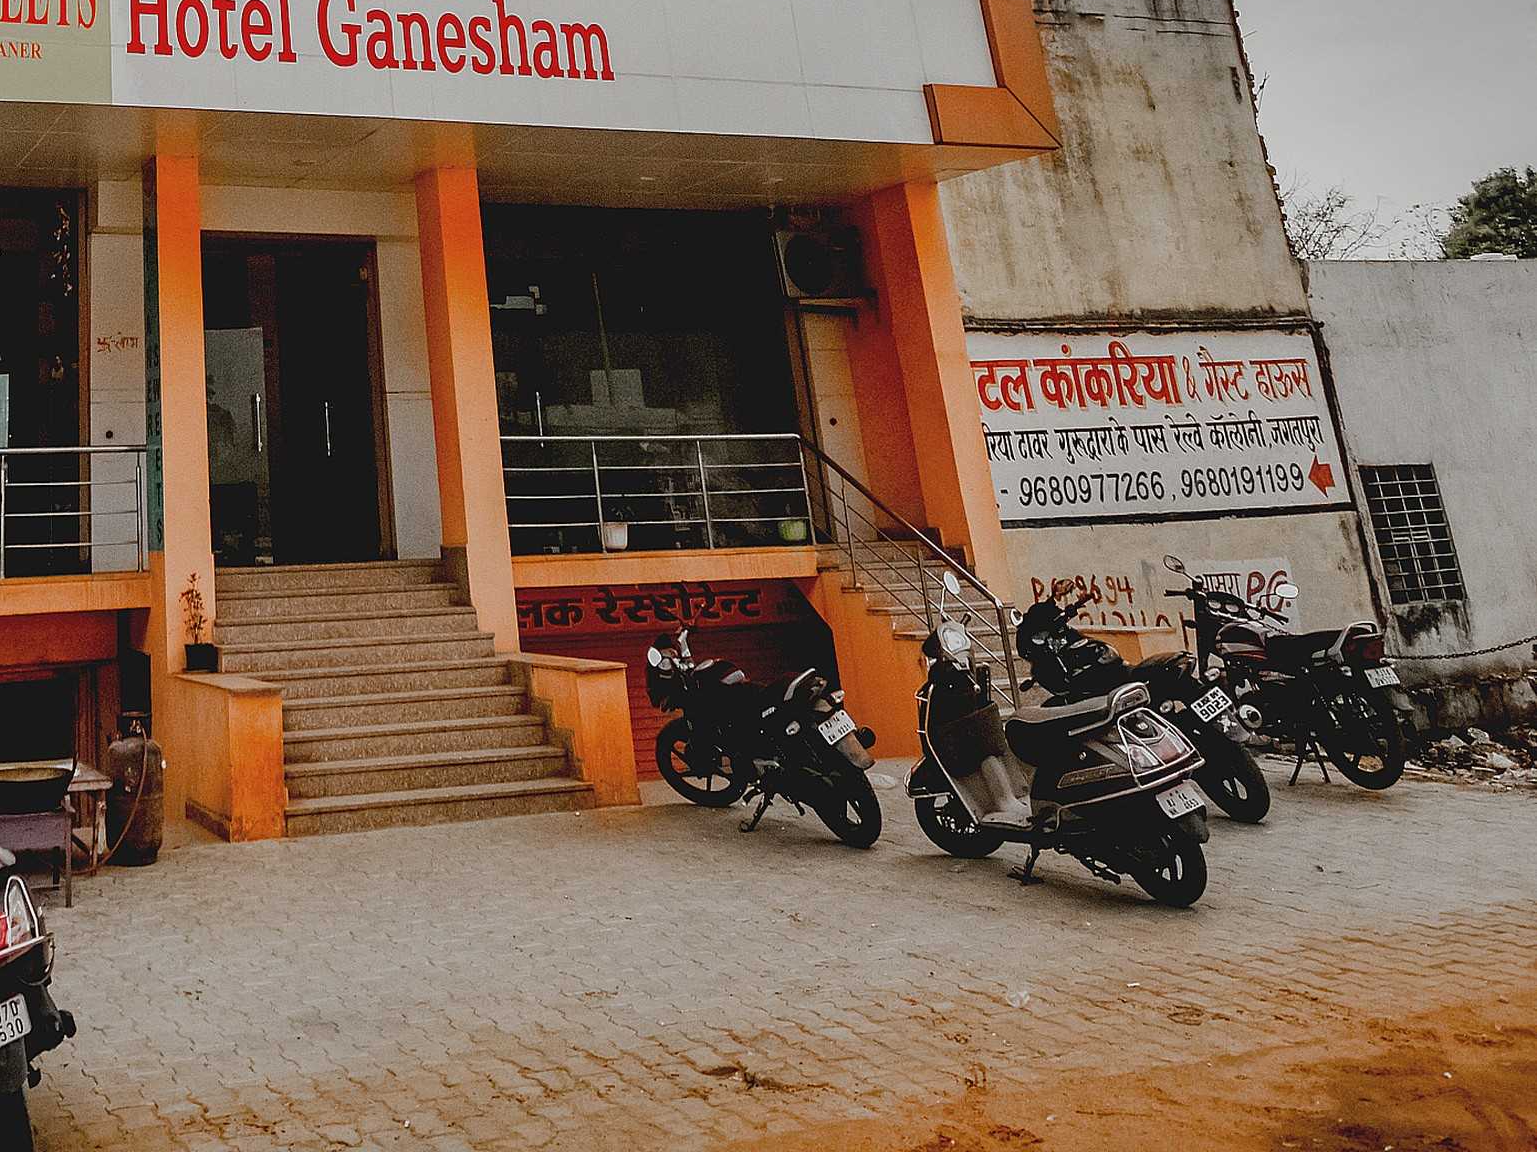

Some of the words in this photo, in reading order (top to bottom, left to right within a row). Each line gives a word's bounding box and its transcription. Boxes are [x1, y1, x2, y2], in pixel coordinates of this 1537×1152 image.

[1032, 340, 1183, 408] कांकरिया
[1129, 424, 1169, 454] पास
[1018, 471, 1164, 506] 9680977266
[1181, 462, 1305, 498] 9680191199
[1199, 693, 1230, 720] 9023
